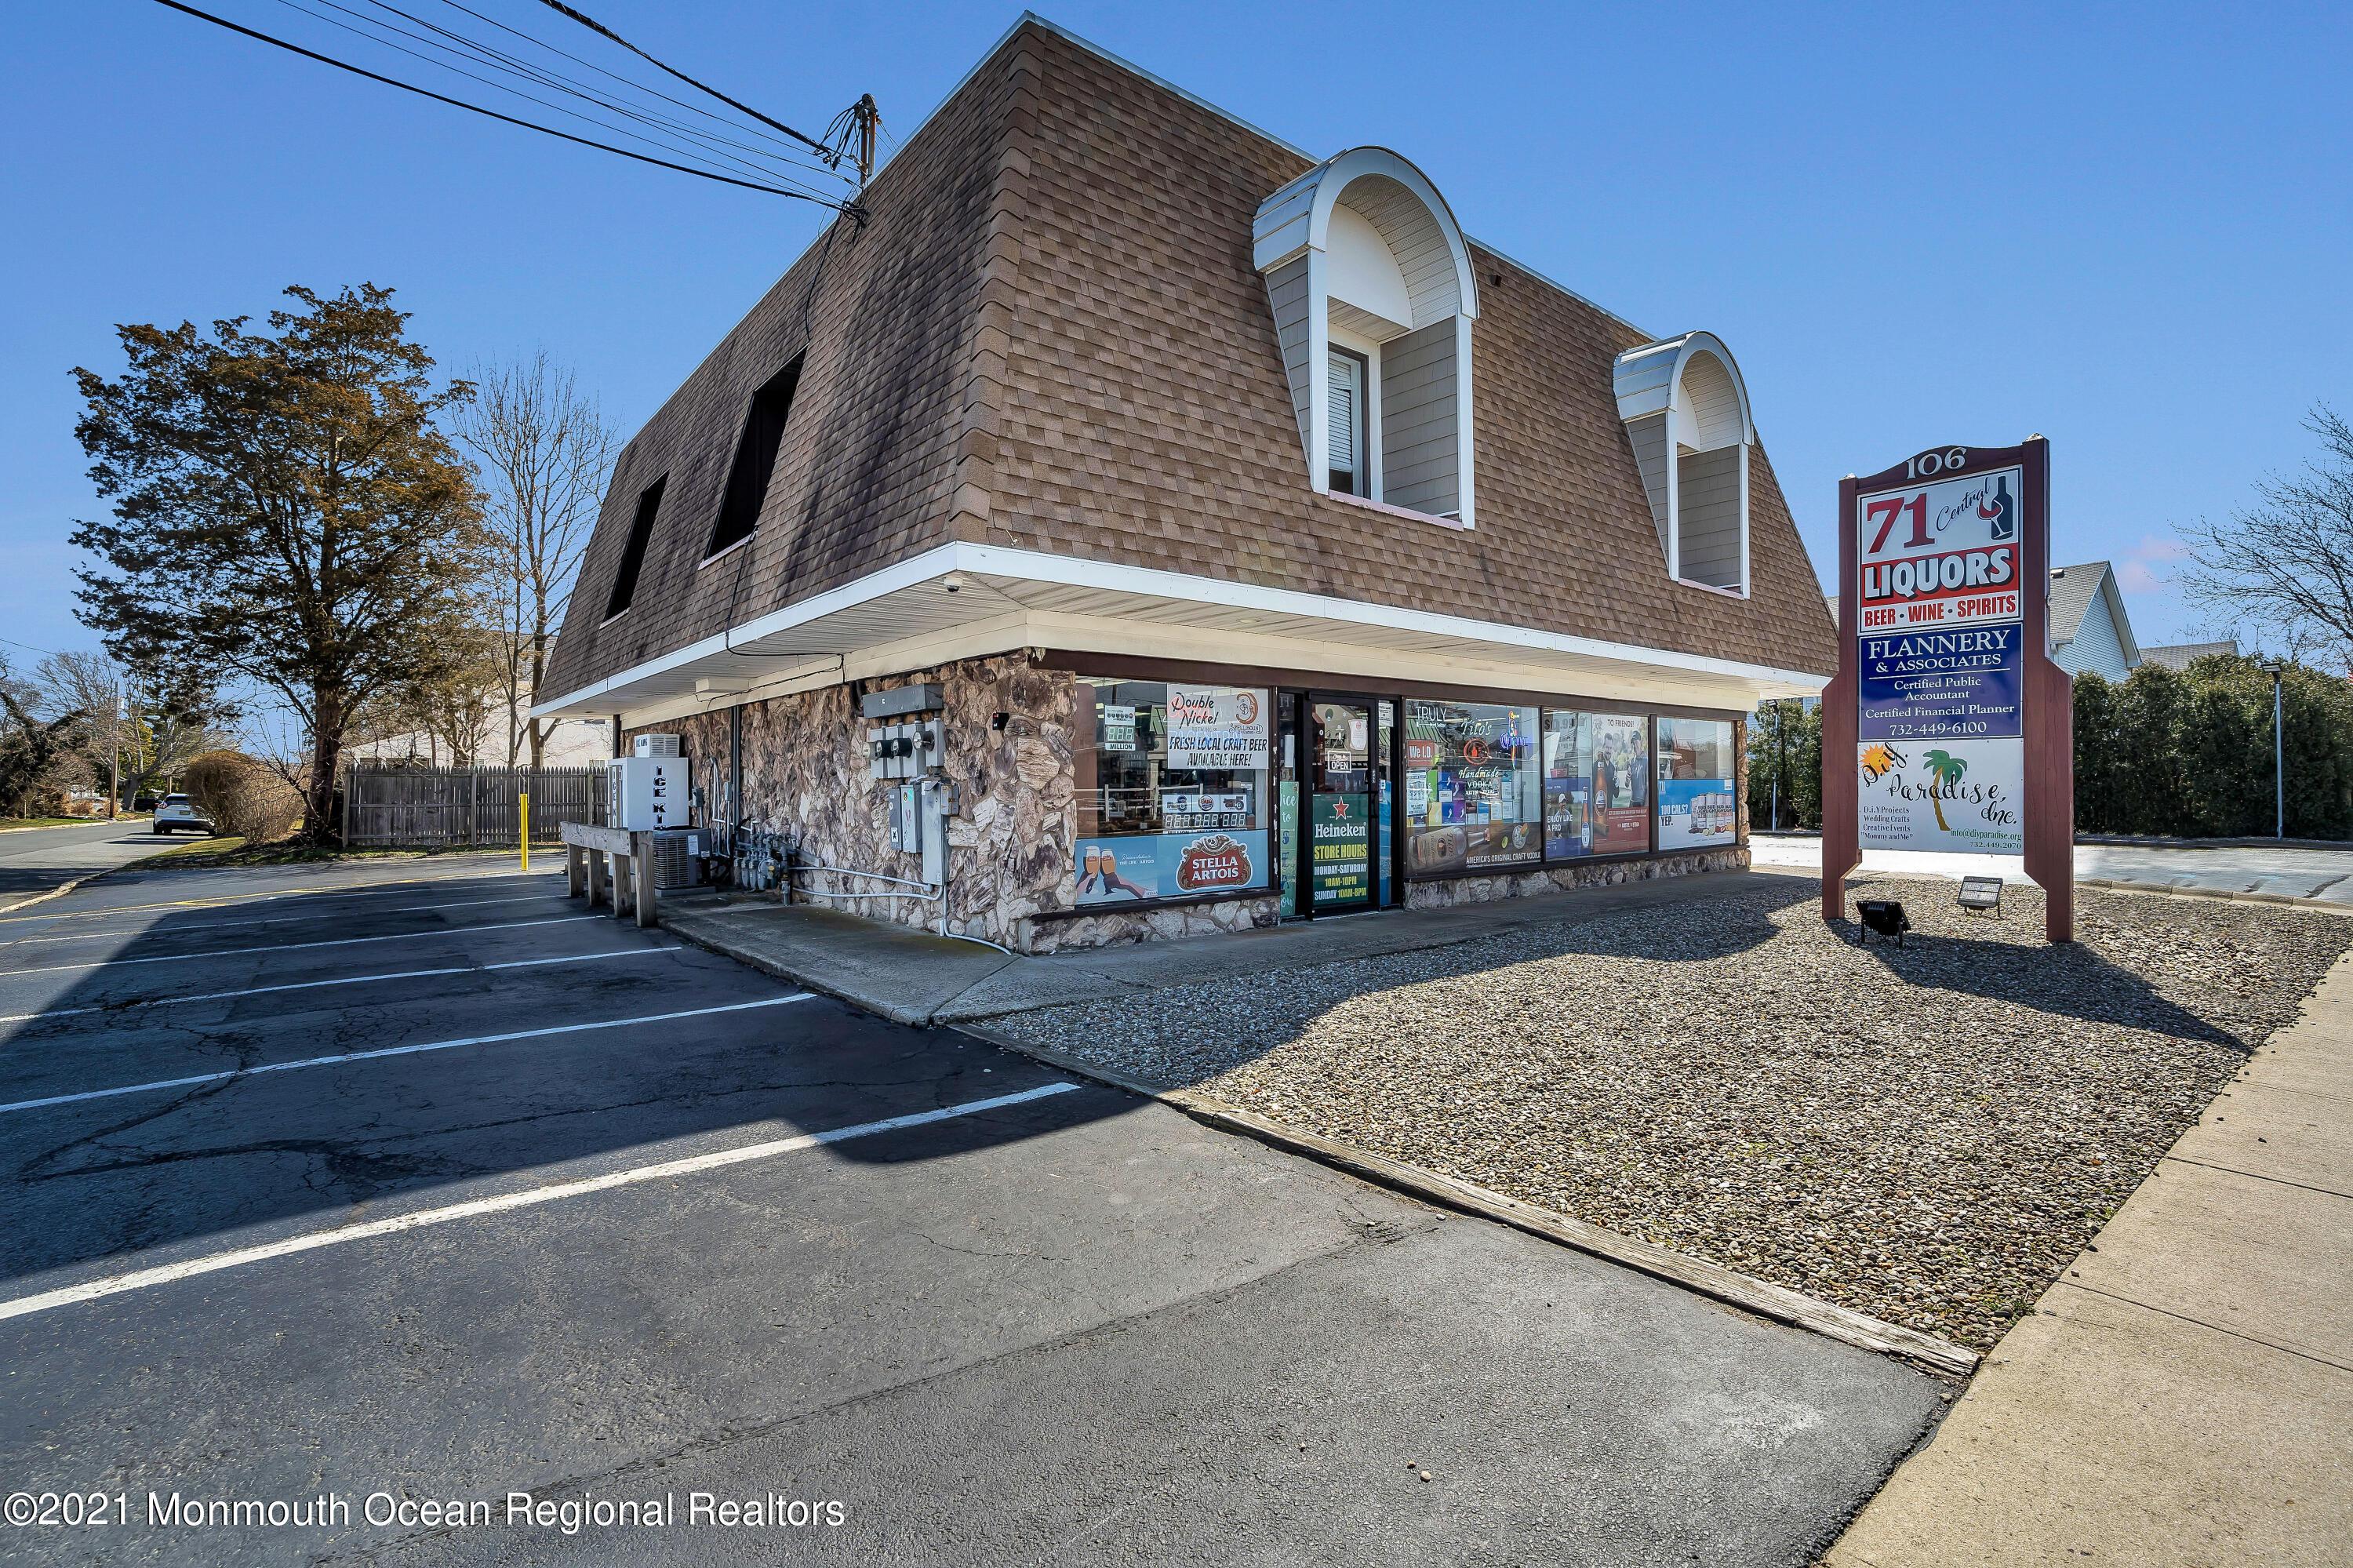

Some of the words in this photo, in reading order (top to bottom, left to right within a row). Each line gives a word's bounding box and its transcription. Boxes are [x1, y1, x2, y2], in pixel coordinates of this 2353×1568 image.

[1906, 446, 1967, 479] 106
[1867, 493, 1935, 555] 71
[1936, 477, 1990, 532] Central
[1864, 548, 2013, 599] LIQUORS
[1864, 609, 1896, 627] BEER
[1908, 602, 1944, 623] WINE
[1957, 595, 2016, 618] SPIRITS
[1868, 629, 2011, 660] FLANNERY
[1875, 662, 1889, 672] &
[1895, 653, 2002, 671] ASSOCIATES
[1894, 678, 1941, 690] Certified
[1945, 677, 1981, 687] Public
[1171, 692, 1214, 712] Double
[1905, 690, 1970, 701] Accountant
[1415, 706, 1447, 722] TRULY
[1865, 708, 1911, 719] Certified
[1915, 705, 1965, 717] Financial
[1968, 704, 2014, 715] Planner
[1179, 708, 1219, 729] Nickel
[1615, 719, 1635, 728] FRIENDS!
[1460, 719, 1493, 736] Tito's
[1889, 722, 1987, 736] 732-449-6100
[1169, 737, 1196, 750] FRESH
[1197, 737, 1221, 751] LOCAL
[1223, 738, 1248, 751] CRAFT
[1249, 739, 1267, 751] BEER
[1187, 752, 1228, 766] AVAILABLE
[1229, 753, 1252, 766] HERE!
[1409, 746, 1420, 759] We
[1422, 746, 1432, 759] I.D.
[1331, 761, 1348, 770] OPEN
[1458, 766, 1499, 779] Handmade
[653, 765, 667, 798] ICE
[1886, 774, 2006, 804] Paradise,
[1280, 794, 1297, 806] ice
[1660, 805, 1670, 815] 100
[1671, 804, 1689, 814] CALS?
[1881, 806, 1909, 814] Projects
[1980, 800, 2017, 826] Inc.
[1282, 812, 1291, 823] to
[1660, 816, 1674, 826] YEP.
[1864, 815, 1889, 824] Wedding
[1315, 823, 1366, 838] Heineken
[1890, 824, 1911, 832] Events
[1950, 828, 2022, 842] info@diyparadise.org
[1969, 841, 2021, 849] 732.449.2070
[1314, 846, 1339, 860] STORE
[1340, 844, 1367, 858] HOURS
[1466, 855, 1491, 864] AMERICA'S
[1491, 853, 1512, 862] ORIGINAL
[1192, 856, 1238, 869] STELLA
[1191, 868, 1239, 881] ARTOIS
[1314, 864, 1367, 875] MONDAY-SATURDAY
[1325, 876, 1357, 887] 10AM-10PM
[1315, 890, 1337, 900] SUNDAY
